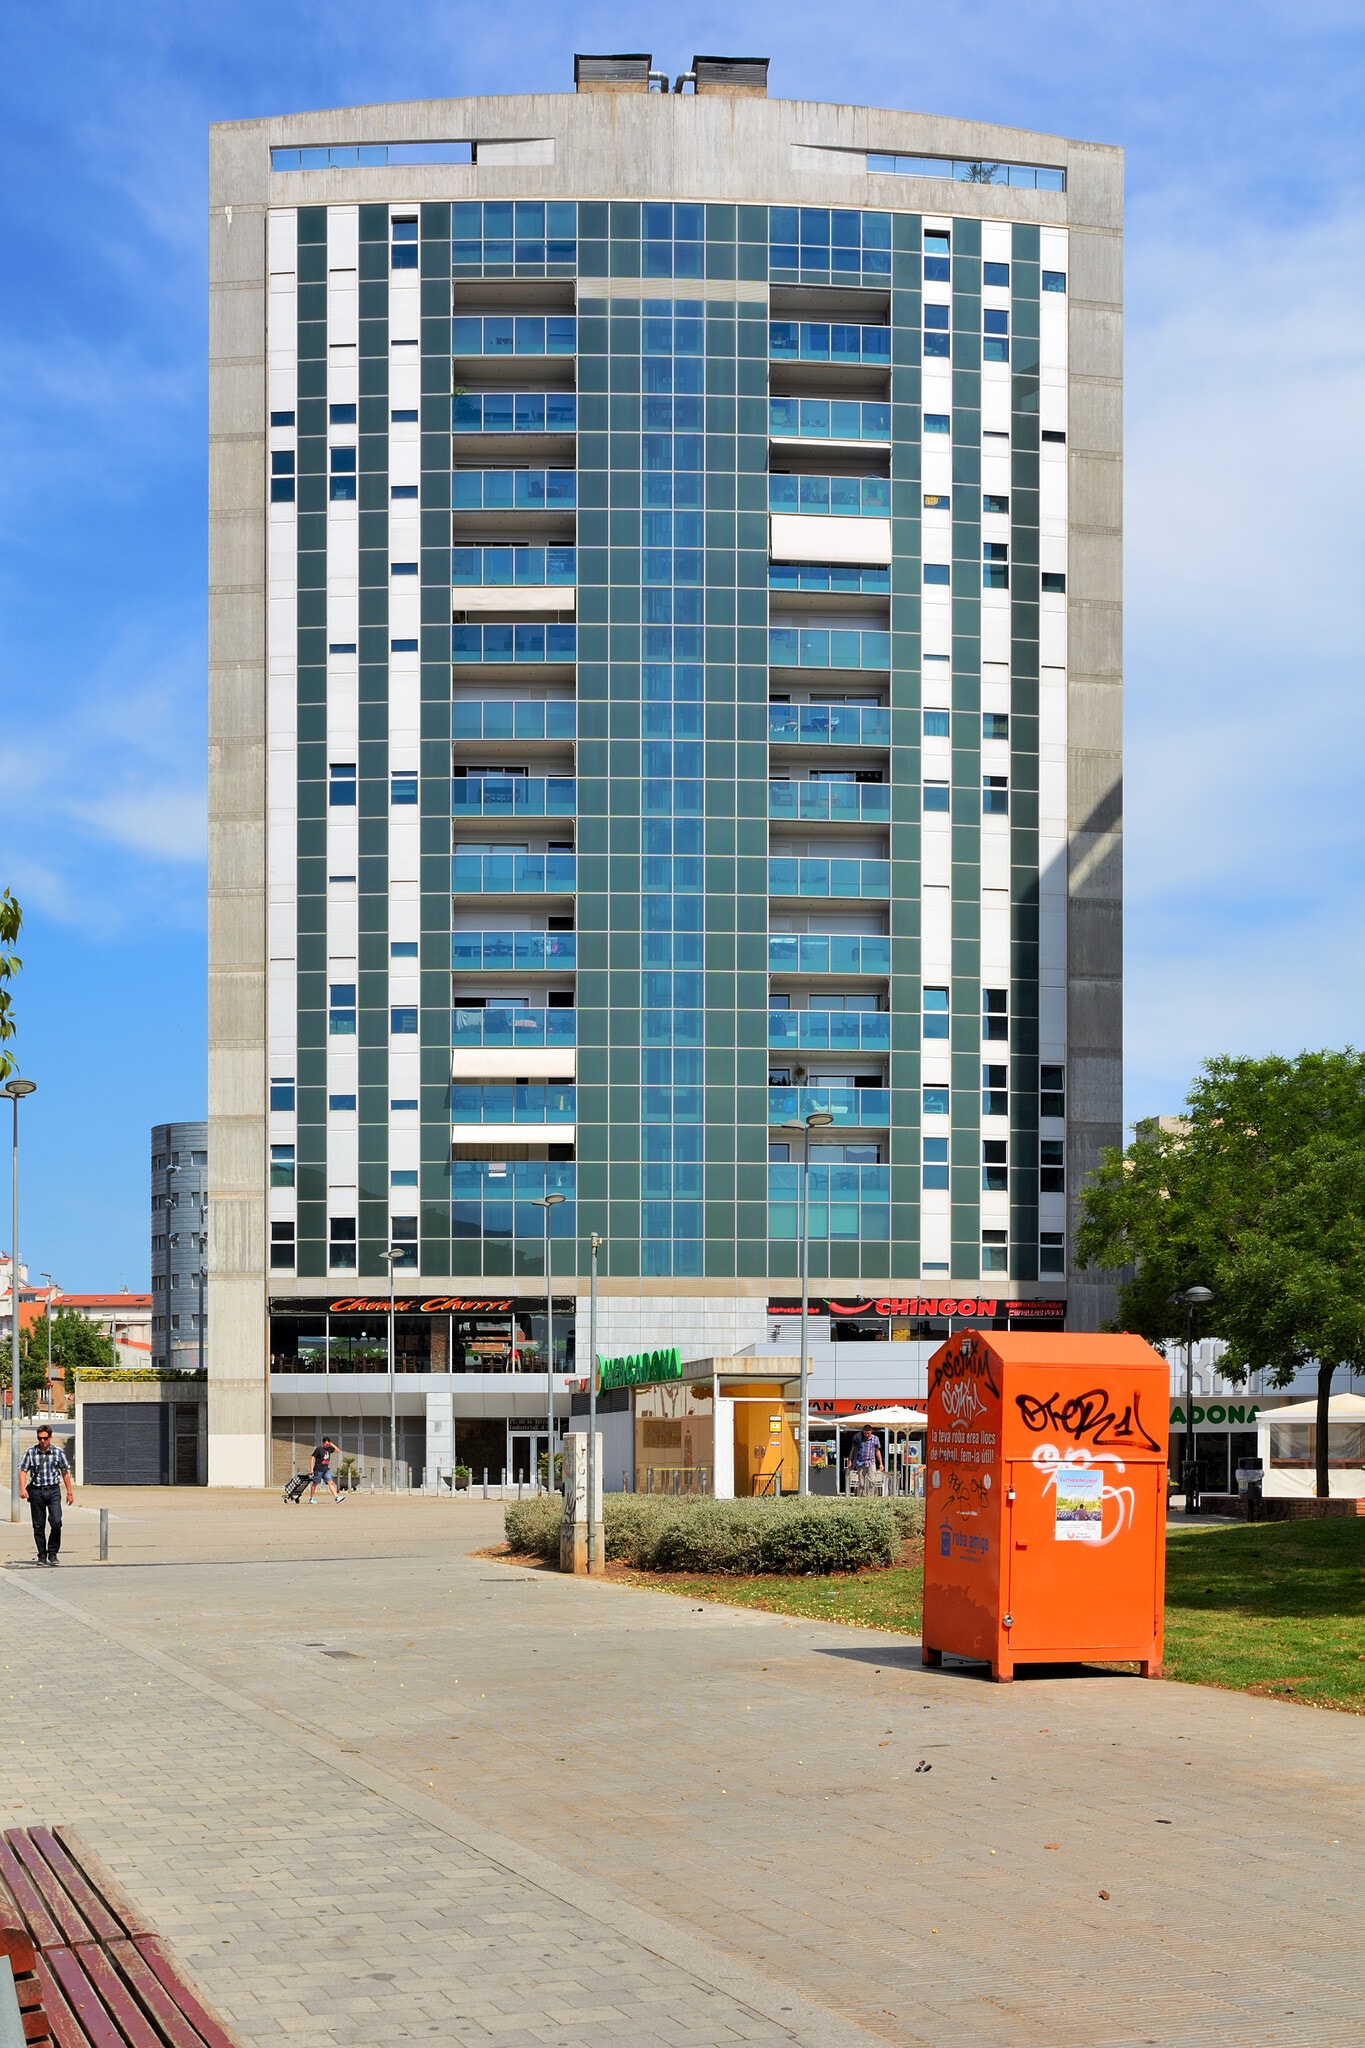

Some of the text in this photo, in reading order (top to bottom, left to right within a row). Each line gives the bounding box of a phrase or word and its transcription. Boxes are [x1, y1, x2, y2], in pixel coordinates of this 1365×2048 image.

[875, 1298, 998, 1316] CHINGON
[604, 1348, 682, 1389] MERCADONA
[809, 1402, 834, 1411] AN
[1170, 1405, 1261, 1424] ADONA
[981, 1430, 996, 1445] llocs
[952, 1529, 989, 1556] roba amiga
